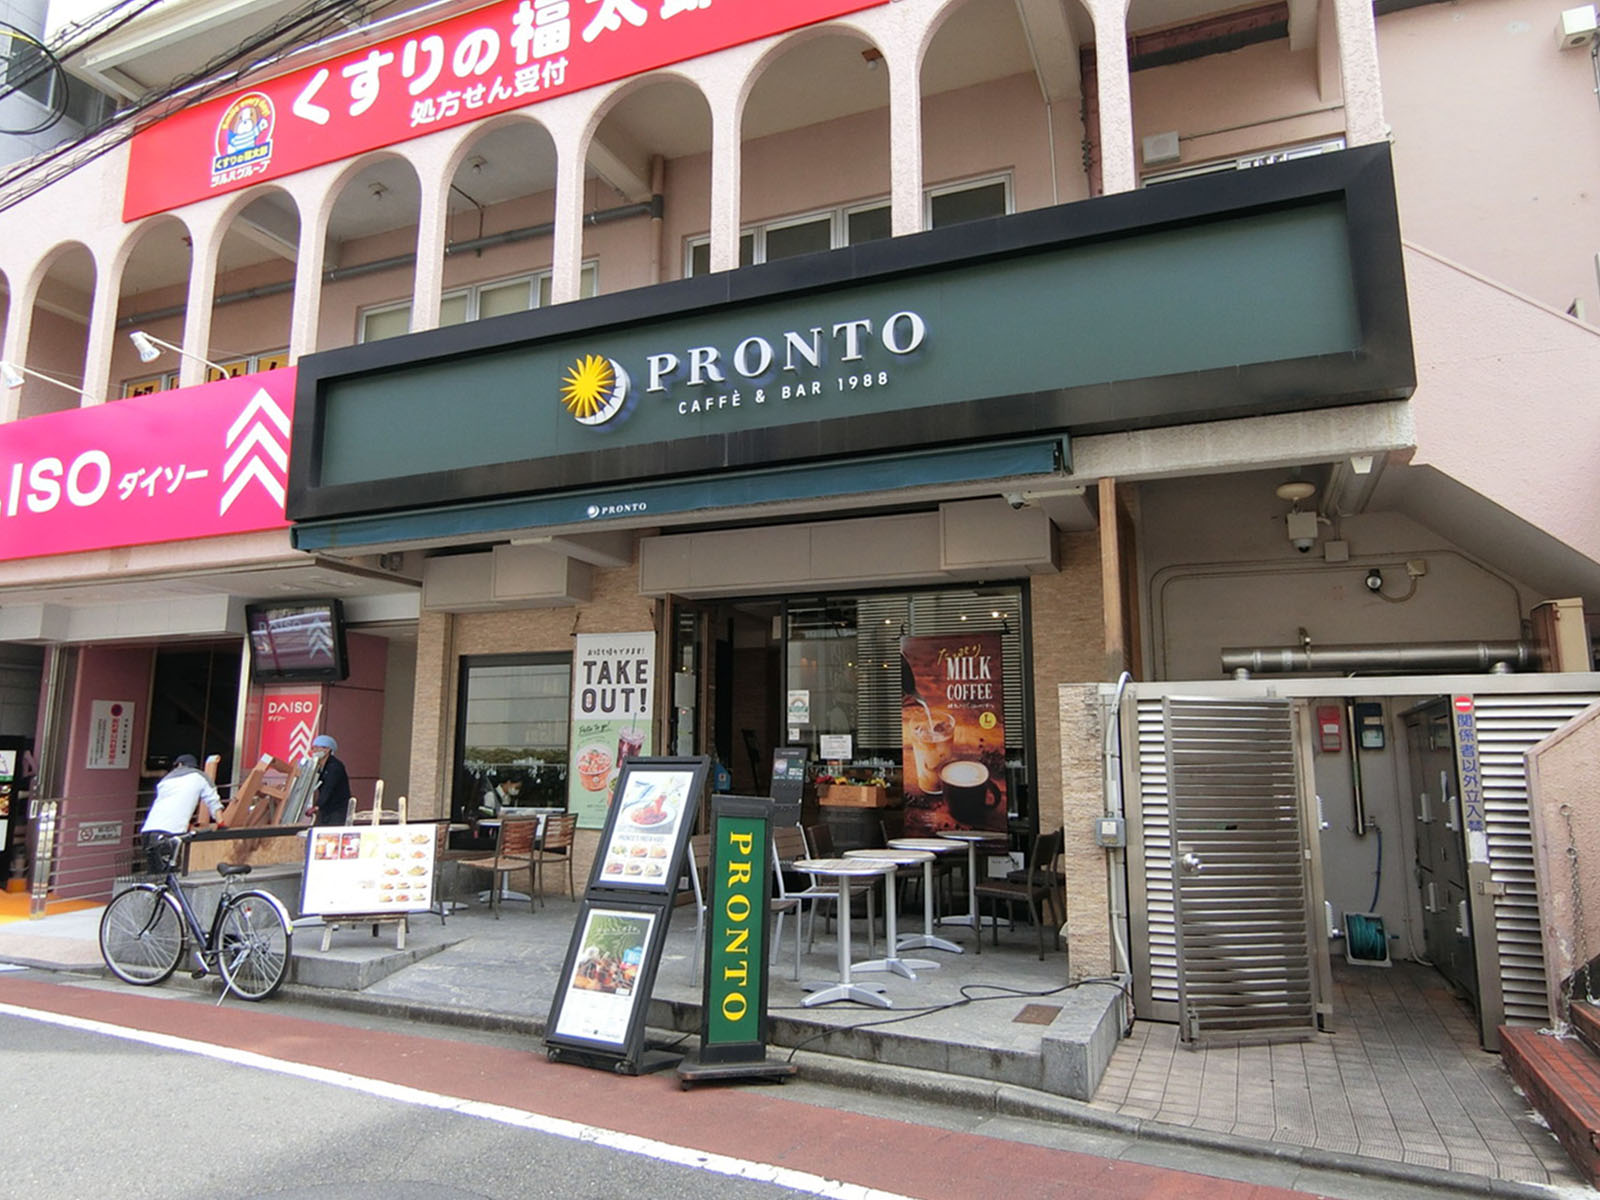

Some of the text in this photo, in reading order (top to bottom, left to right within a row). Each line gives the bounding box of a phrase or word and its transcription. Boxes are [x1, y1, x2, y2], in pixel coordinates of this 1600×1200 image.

[293, 0, 712, 125] くすりの福太
[410, 57, 569, 127] 処方せん受付
[646, 311, 926, 392] PRONTO
[678, 372, 889, 415] CAFFÈ & BAR 1988
[0, 449, 112, 517] ISO
[118, 465, 209, 501] ダイソー
[601, 502, 647, 516] PRONTO
[583, 659, 648, 685] TAKE
[946, 655, 991, 680] MILK
[268, 701, 313, 714] DAISO
[581, 688, 647, 713] OUT!
[946, 683, 993, 700] COFFEE
[722, 832, 753, 1021] PRONTO
